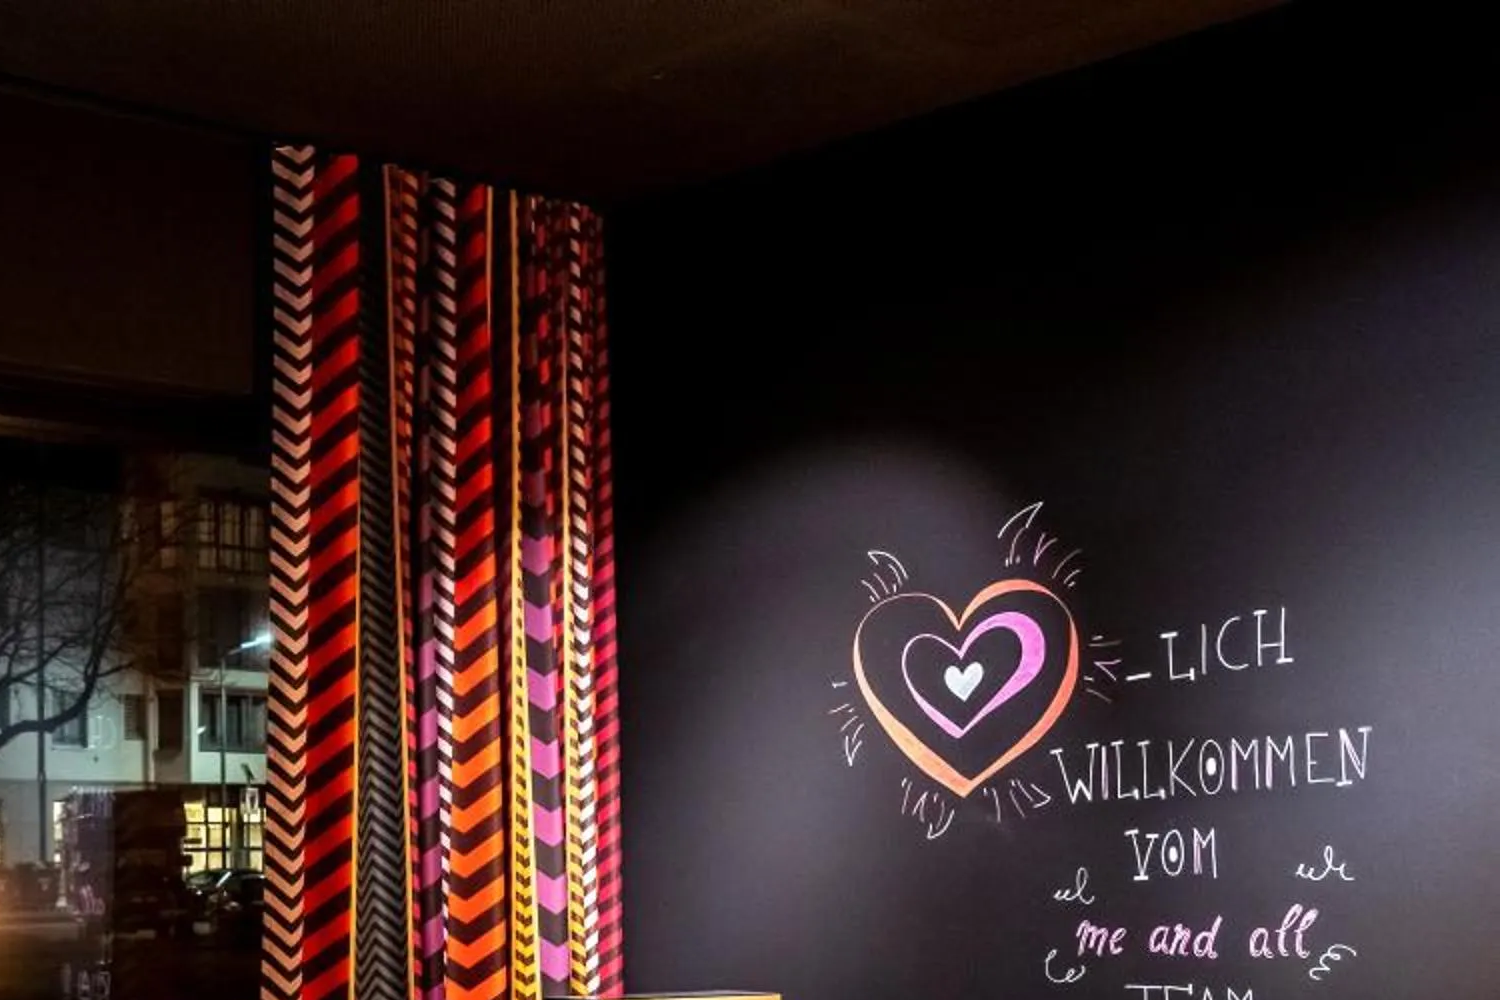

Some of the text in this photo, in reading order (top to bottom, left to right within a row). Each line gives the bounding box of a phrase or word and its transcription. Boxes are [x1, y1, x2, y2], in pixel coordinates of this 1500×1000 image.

[1050, 726, 1373, 804] WILLKOMMEN
[1124, 827, 1218, 881] VOM
[1075, 903, 1320, 960] me and all
